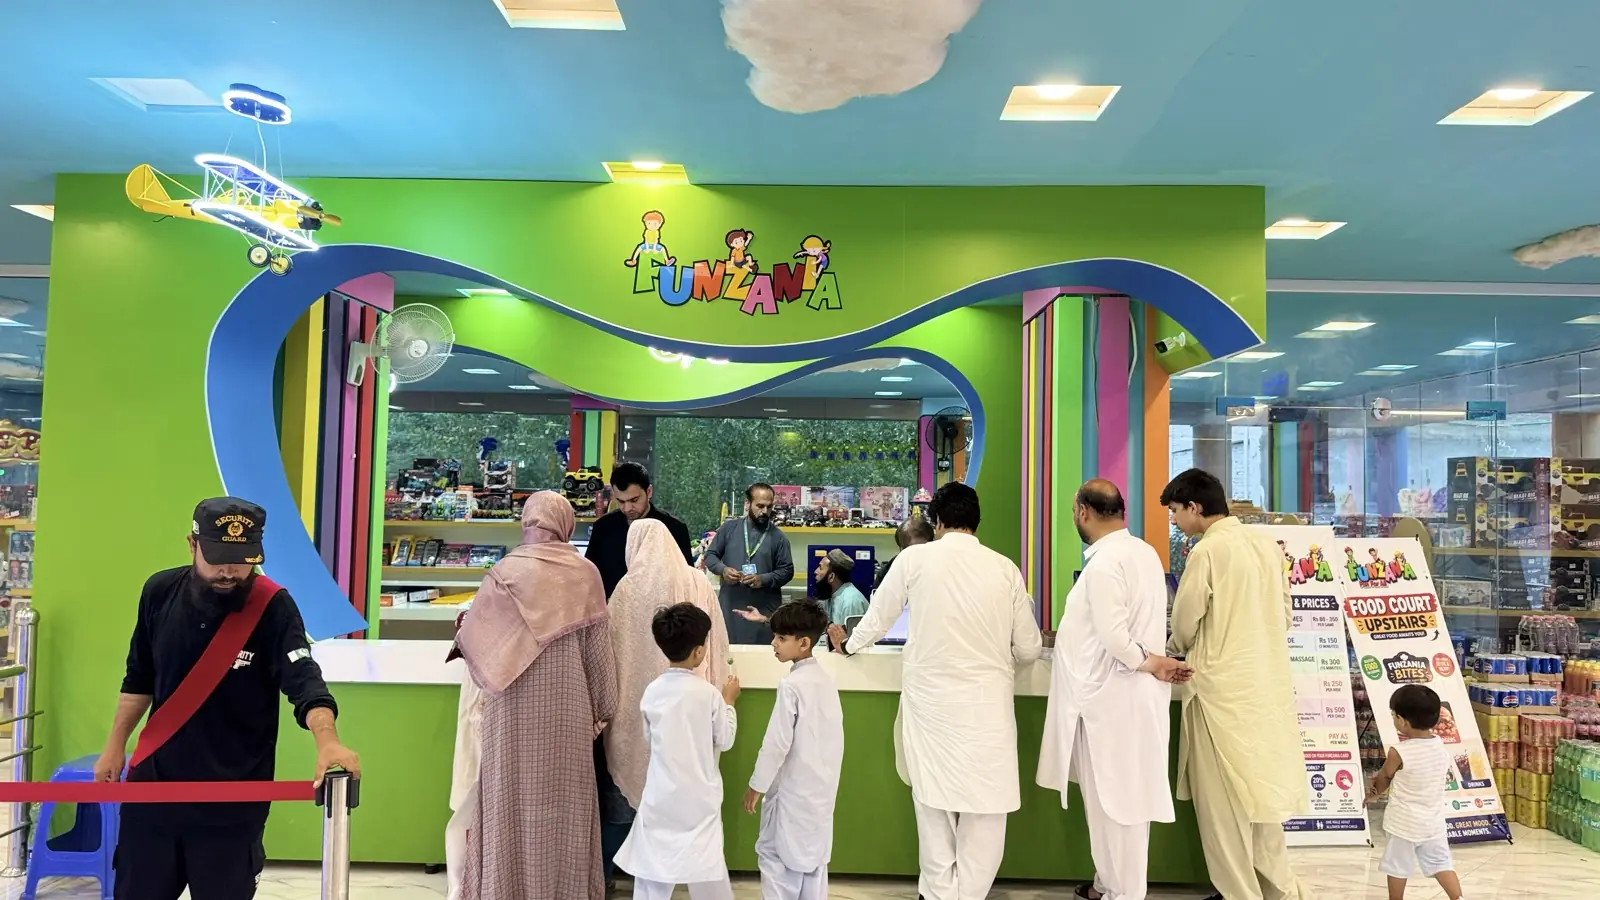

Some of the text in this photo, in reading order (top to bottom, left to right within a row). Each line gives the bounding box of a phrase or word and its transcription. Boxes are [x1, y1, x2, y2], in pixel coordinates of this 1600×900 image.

[633, 250, 843, 316] FUNZANIA
[215, 515, 255, 528] SECURITY
[1347, 560, 1418, 584] FUNZANIA
[1294, 598, 1330, 608] & PRICES
[1349, 596, 1431, 616] FOOD COURT
[1364, 615, 1427, 631] UPSTAIRS
[1388, 660, 1426, 670] FUNZANIA
[1395, 668, 1424, 679] BITES
[1455, 821, 1472, 829] GREAT
[1446, 828, 1491, 838] ABLE MOMENTS.
